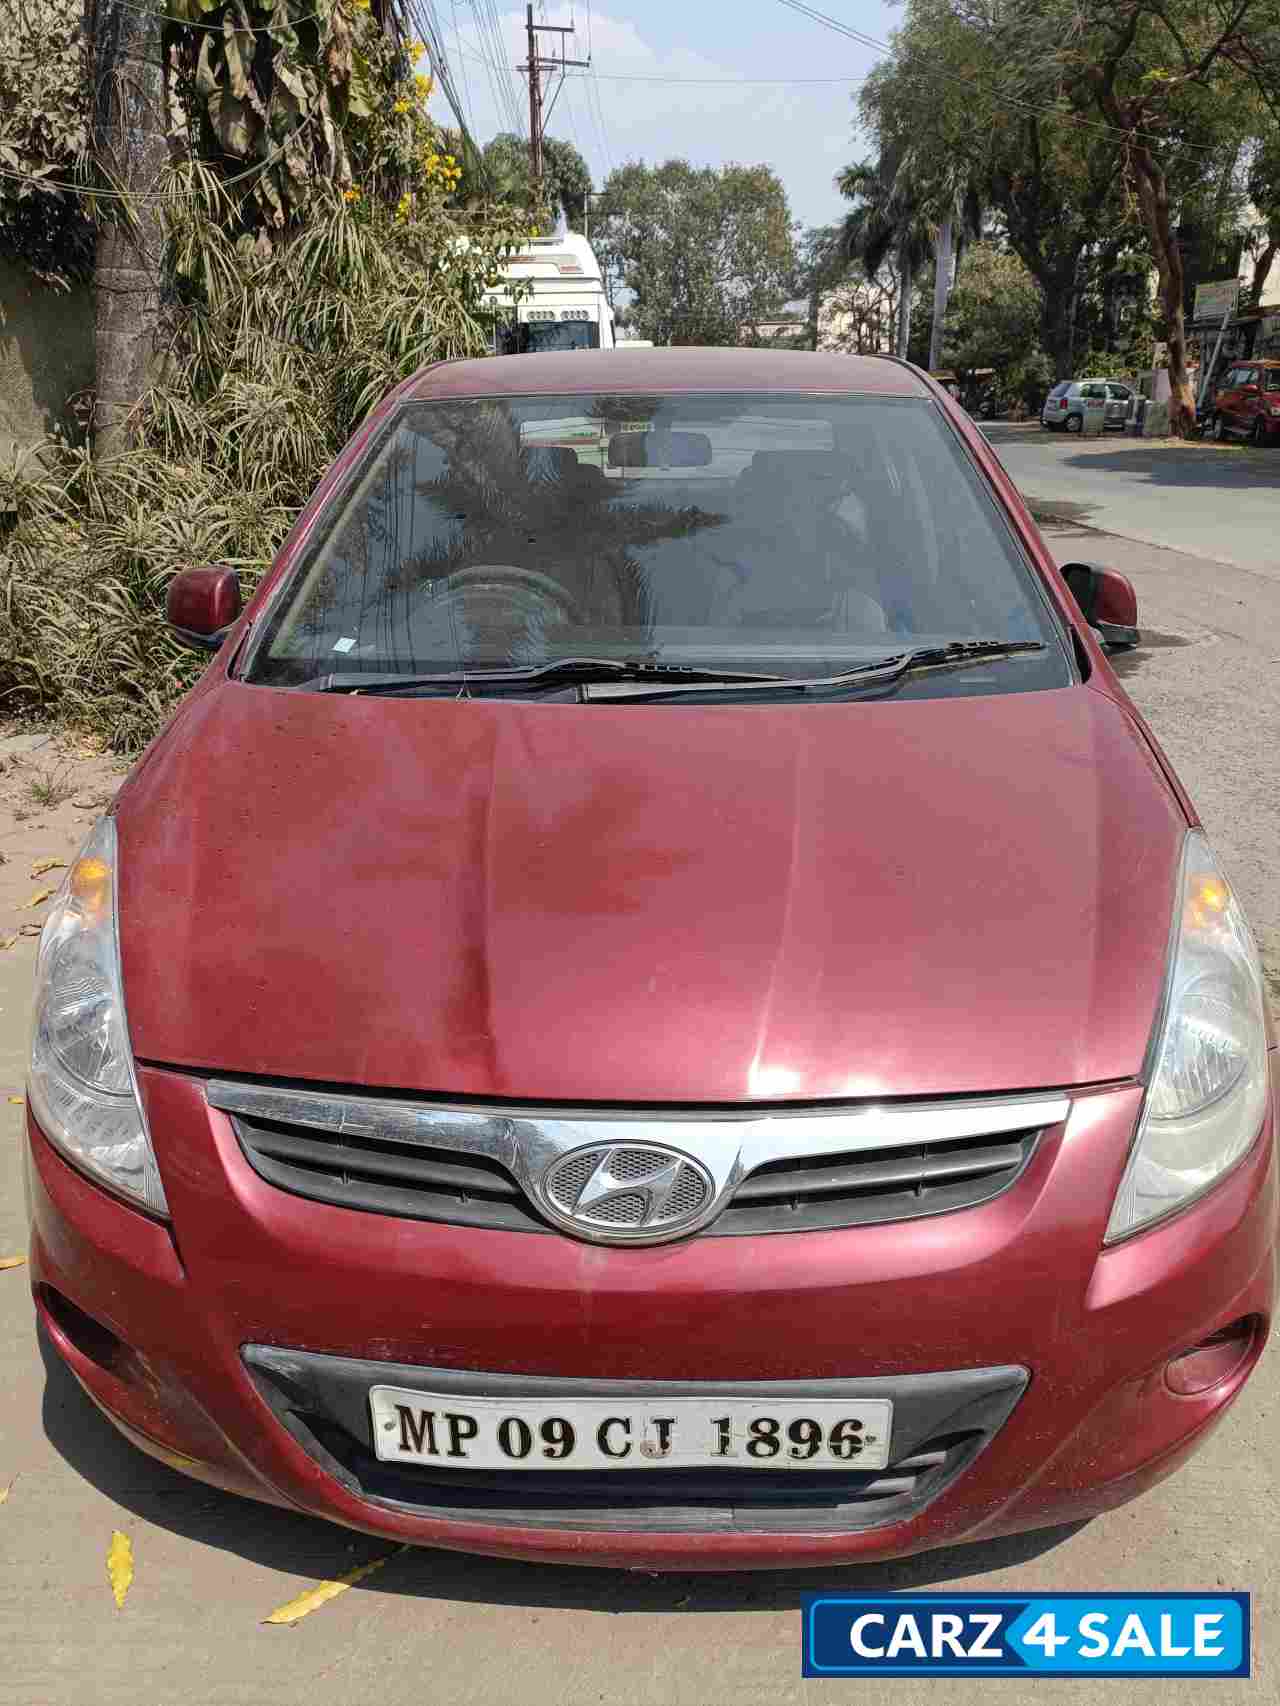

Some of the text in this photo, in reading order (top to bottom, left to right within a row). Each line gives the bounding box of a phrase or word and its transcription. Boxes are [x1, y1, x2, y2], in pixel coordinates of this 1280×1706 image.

[393, 1404, 867, 1460] MP 09 CJ 1896
